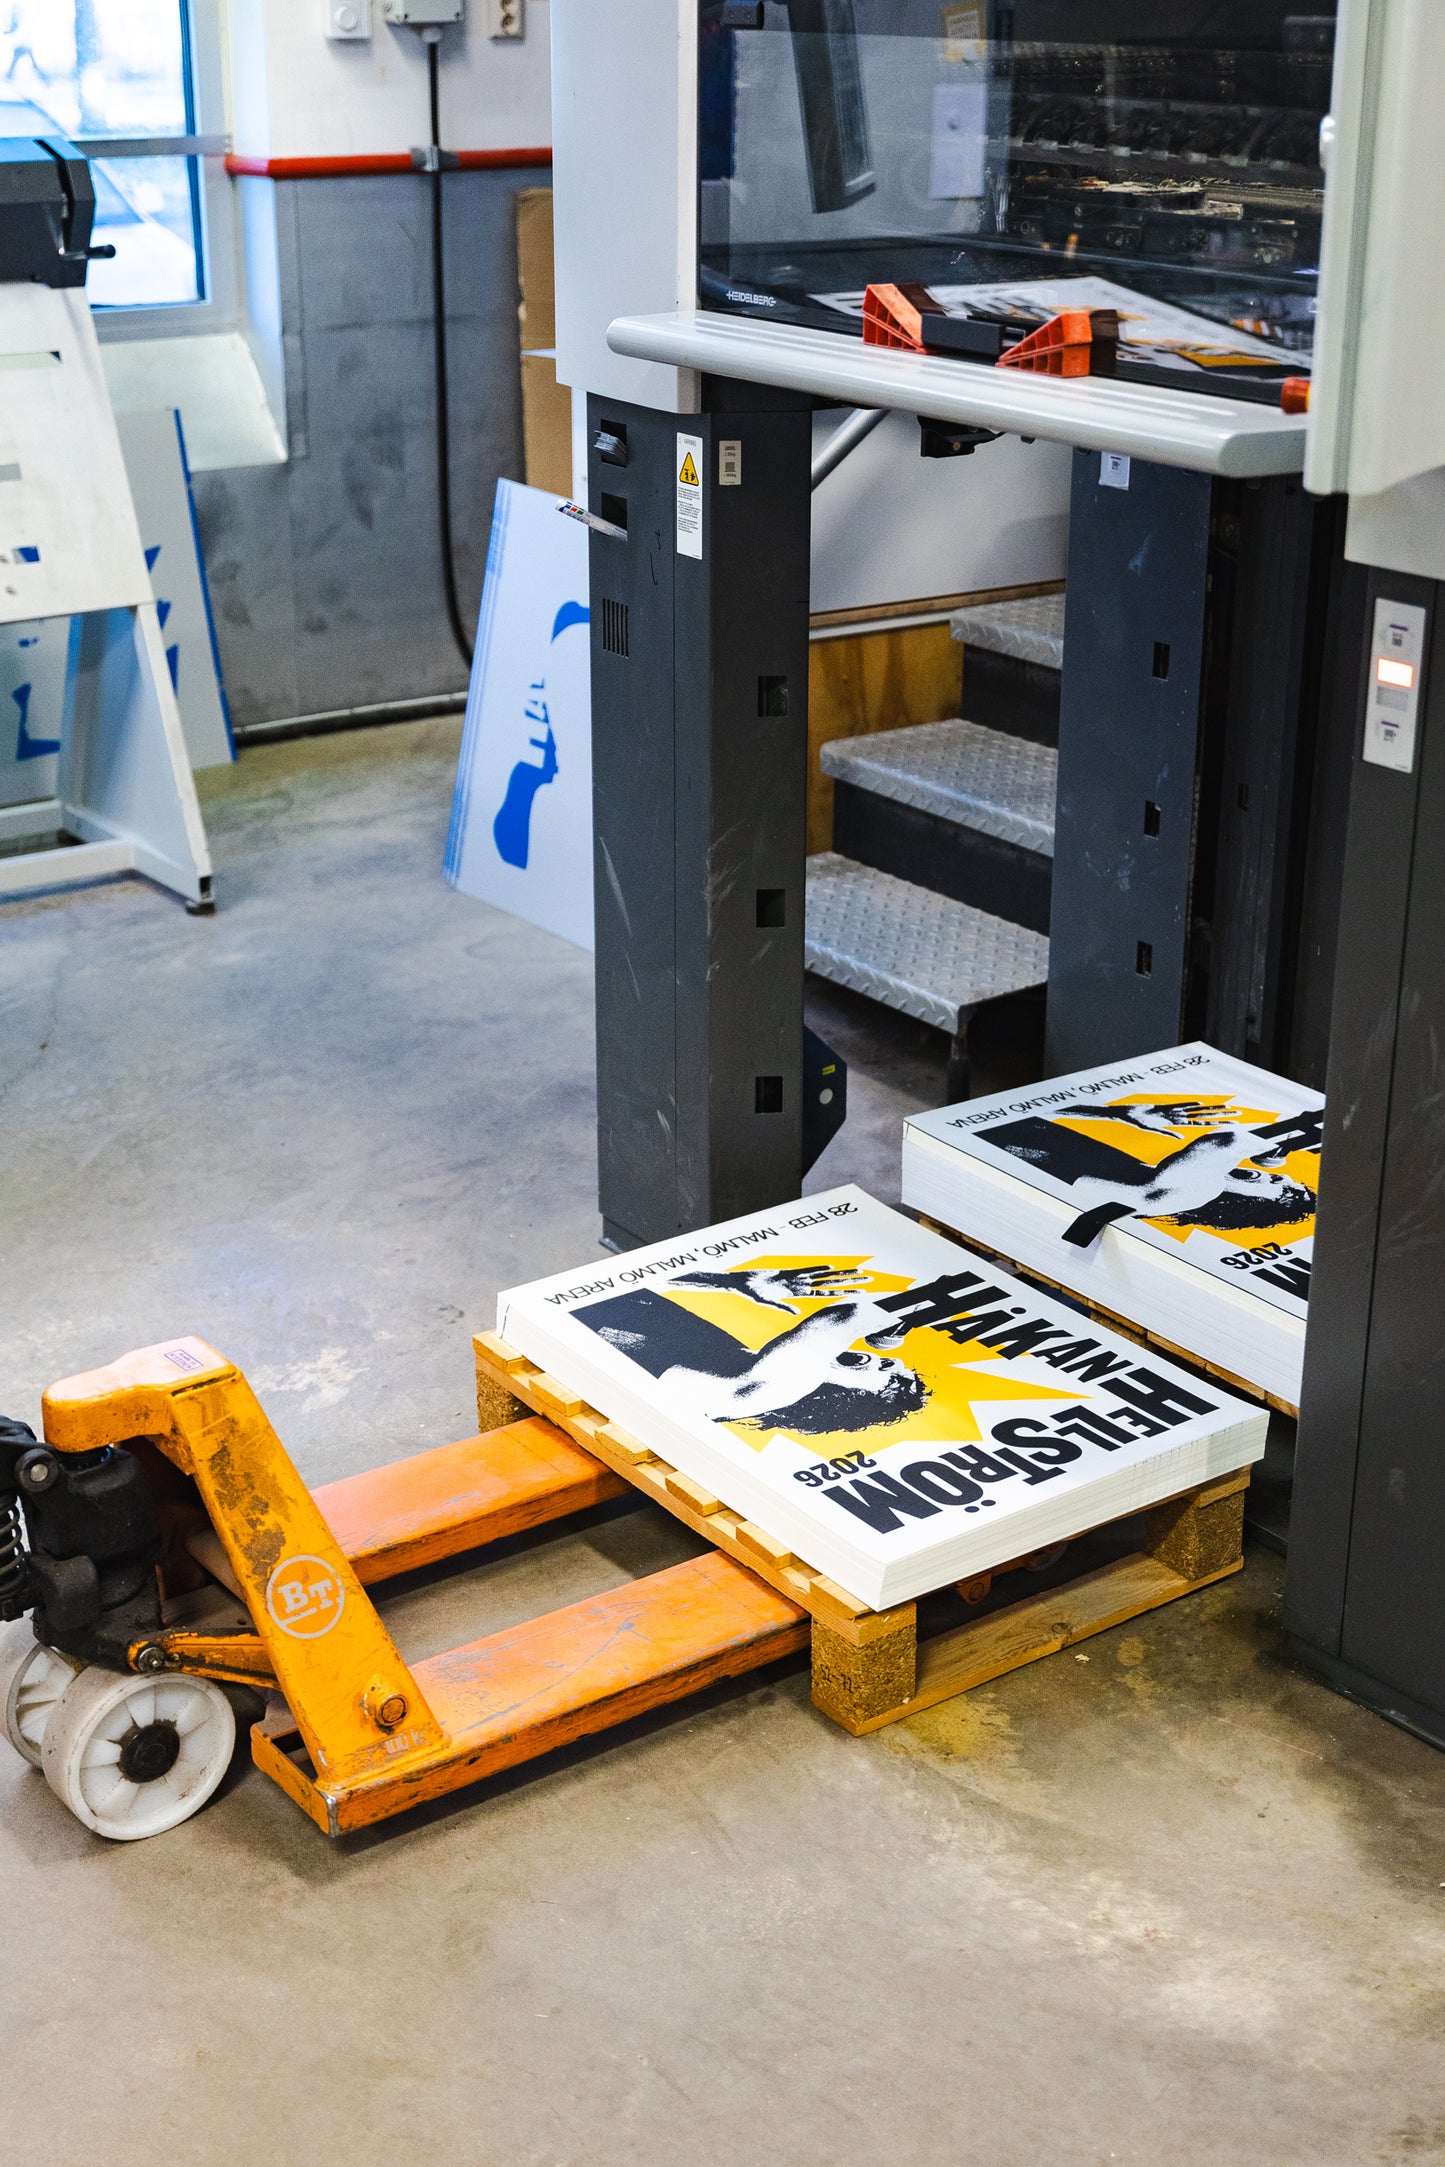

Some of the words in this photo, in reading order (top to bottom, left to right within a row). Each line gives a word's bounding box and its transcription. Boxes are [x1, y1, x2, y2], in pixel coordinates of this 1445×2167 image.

[726, 290, 777, 307] HEIDELBERG
[1149, 1060, 1186, 1075] FEB
[1181, 1054, 1211, 1069] 28
[1008, 1089, 1077, 1115] MALMÖ
[945, 1106, 1008, 1129] ARENA
[788, 1211, 830, 1230] FEB
[827, 1202, 859, 1218] 28
[619, 1252, 698, 1286] MALMÖ
[1219, 1241, 1294, 1270] 2026
[544, 1277, 615, 1306] ARENA
[872, 1270, 1134, 1384] HÅKAN
[821, 1367, 1220, 1534] HELLSTRÖM
[792, 1450, 878, 1488] 2026
[277, 1578, 334, 1613] BT
